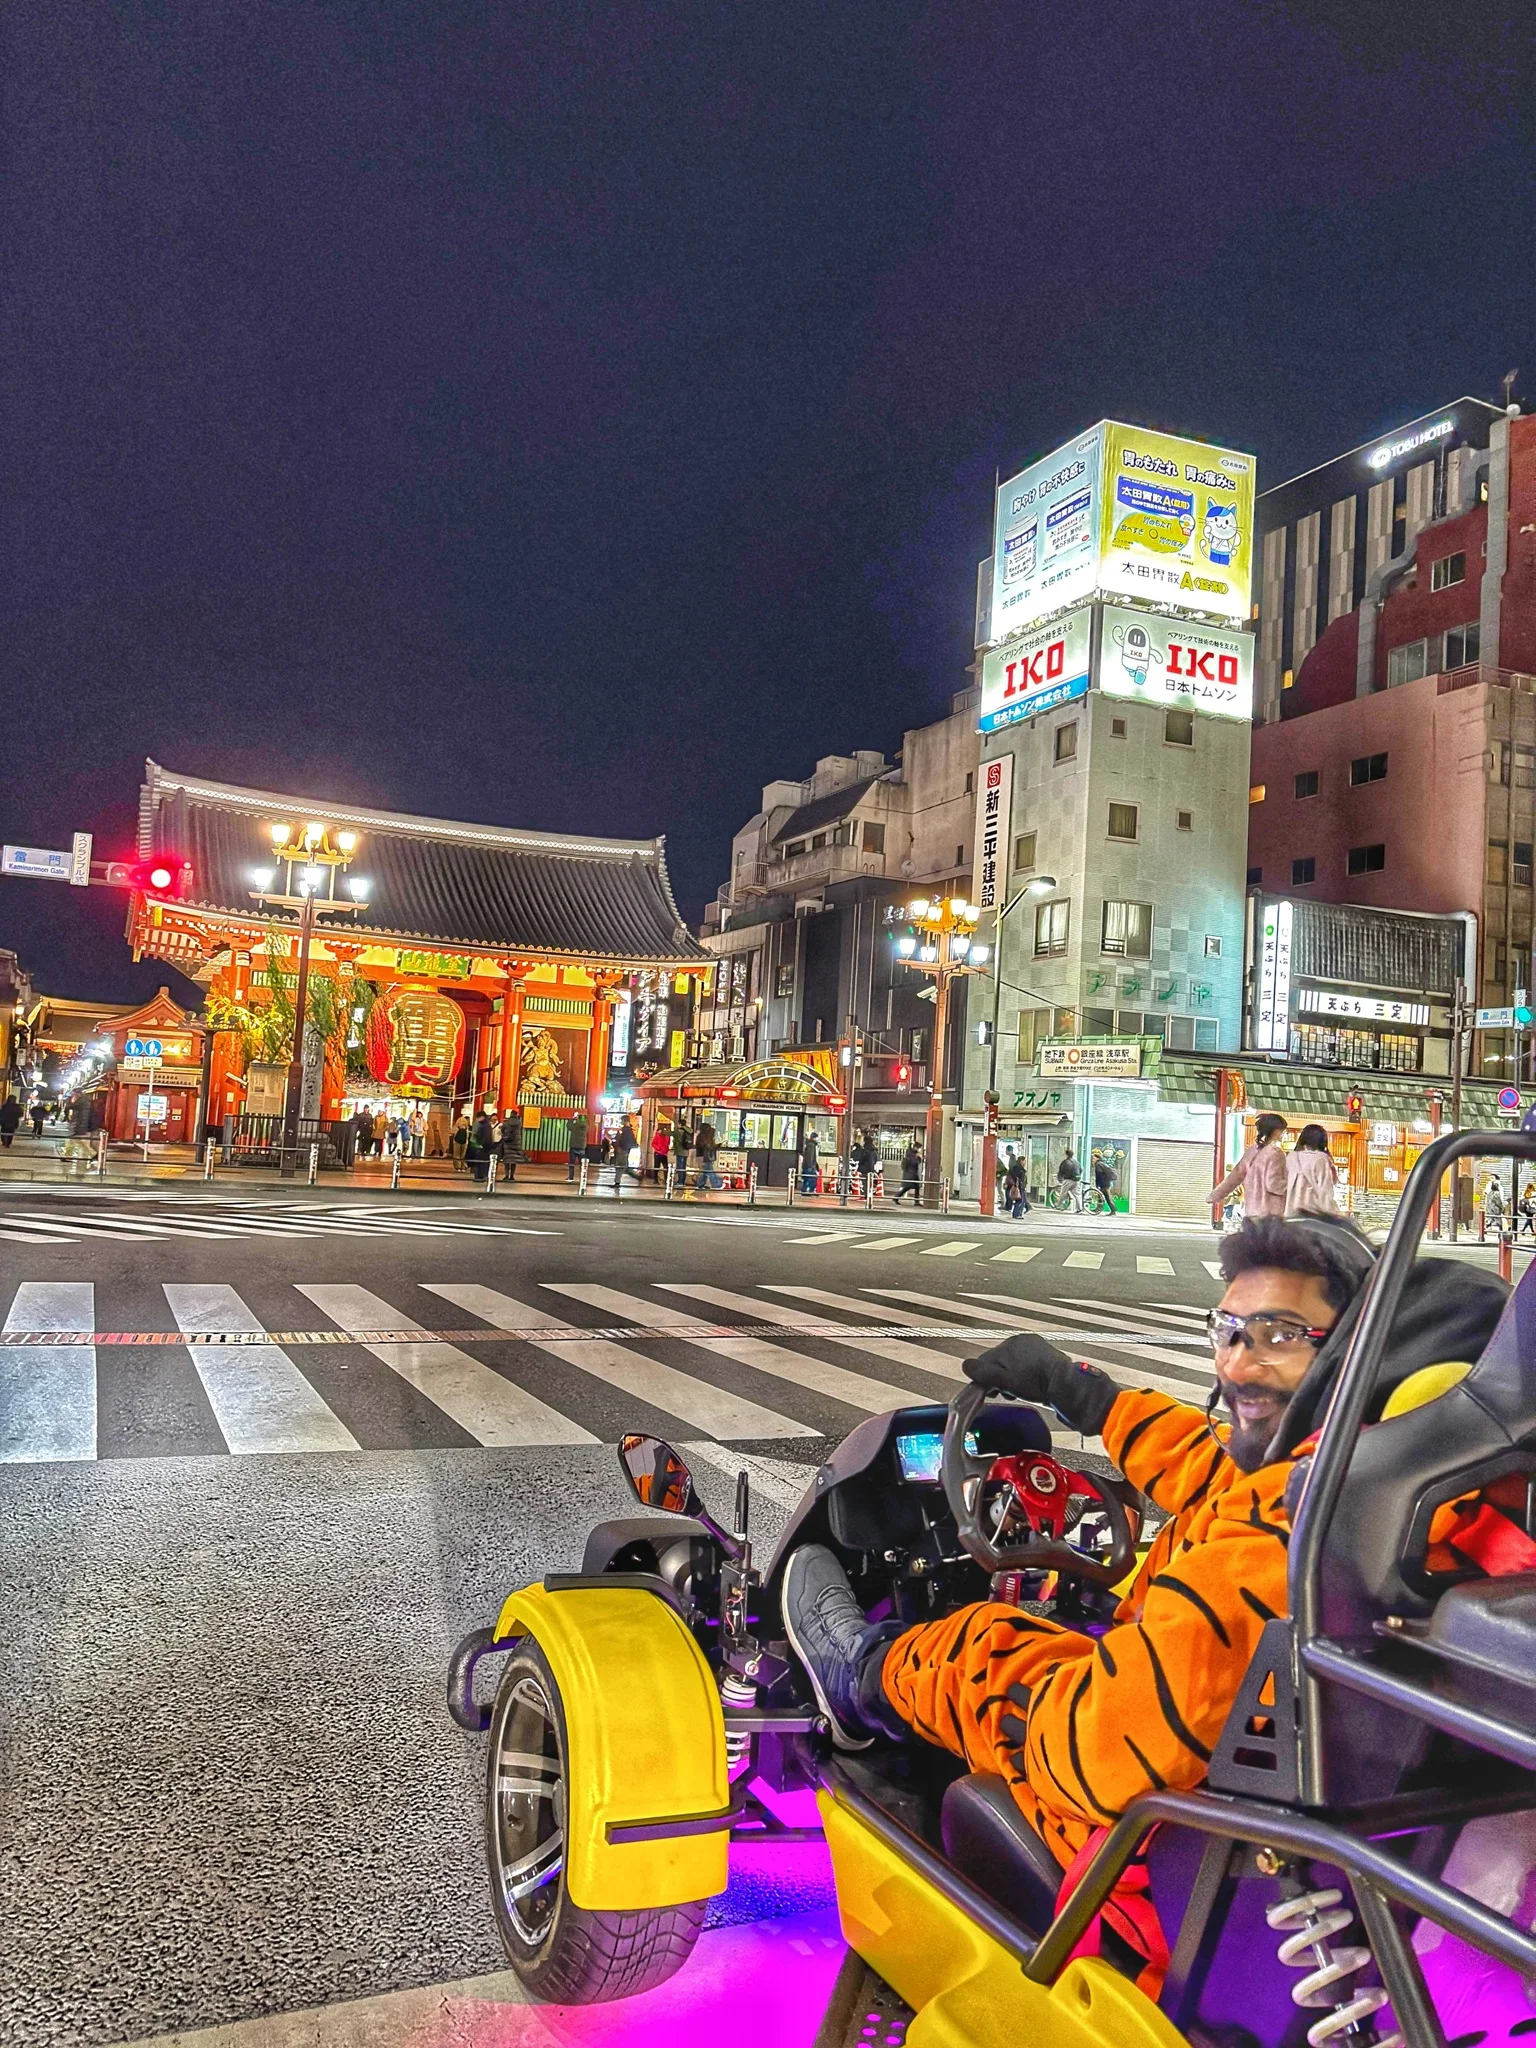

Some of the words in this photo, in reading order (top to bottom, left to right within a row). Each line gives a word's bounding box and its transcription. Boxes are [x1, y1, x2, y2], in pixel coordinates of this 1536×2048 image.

[1391, 435, 1418, 457] TOBU
[1420, 420, 1454, 446] HOTEL
[1012, 488, 1036, 515] 胸やけ
[1039, 461, 1085, 499] 胃の不快感に
[1122, 449, 1178, 477] 胃のもたれ
[1185, 464, 1236, 490] 胃の痛みに
[1003, 640, 1065, 699] IKO
[1130, 649, 1143, 658] IKO
[1166, 644, 1238, 685] IKO
[993, 685, 1072, 725] 日本トムソン株式会社
[1165, 679, 1237, 701] 日本トムソン
[75, 835, 87, 883] スクランブル式
[981, 788, 1000, 908] 新三平建設
[8, 863, 48, 873] Kaminarimon
[50, 866, 65, 875] Gate
[1328, 997, 1361, 1014] 天ぷら
[1374, 1003, 1403, 1020] 三定
[1045, 1049, 1065, 1058] 地下鉄
[1081, 1049, 1103, 1058] 銀座線
[1106, 1049, 1130, 1058] 浅草駅
[1014, 1091, 1061, 1108] アオノヤ
